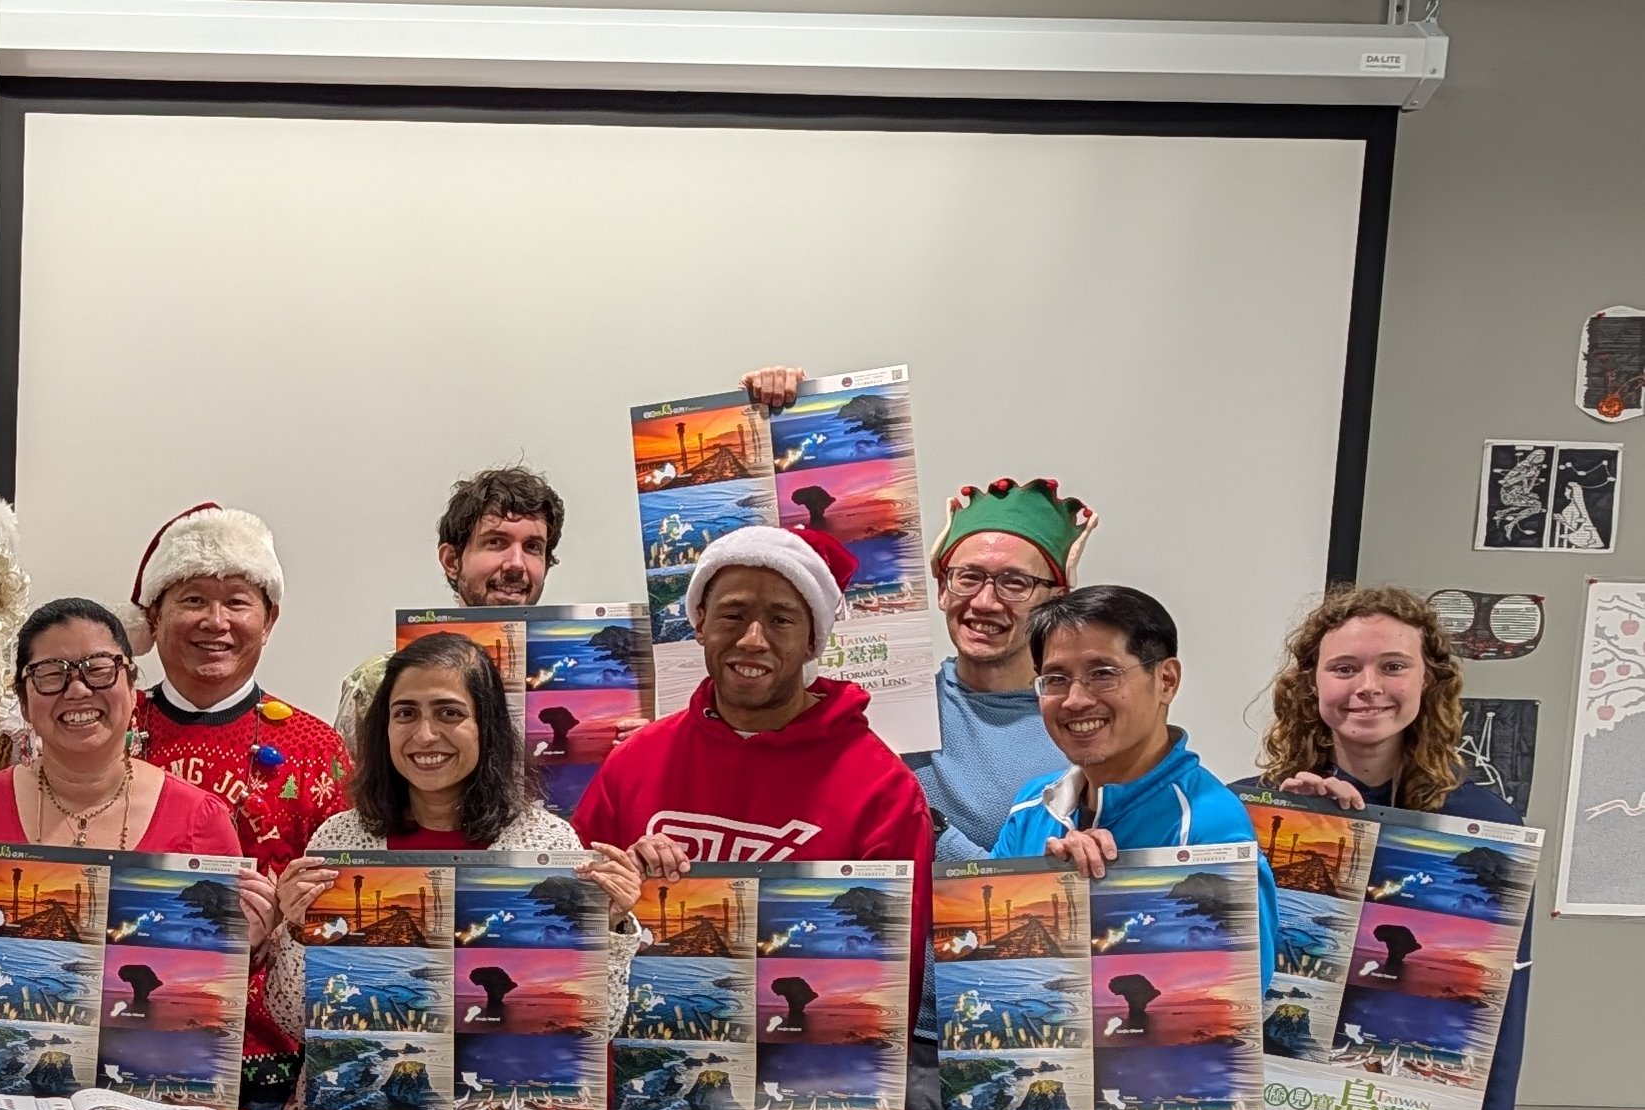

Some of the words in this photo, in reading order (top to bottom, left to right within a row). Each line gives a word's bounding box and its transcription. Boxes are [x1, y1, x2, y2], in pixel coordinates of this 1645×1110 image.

[837, 633, 888, 647] TAIWAN
[840, 668, 889, 681] FORMOSA
[882, 677, 907, 688] LENS
[1375, 1087, 1431, 1110] TAIWAN
